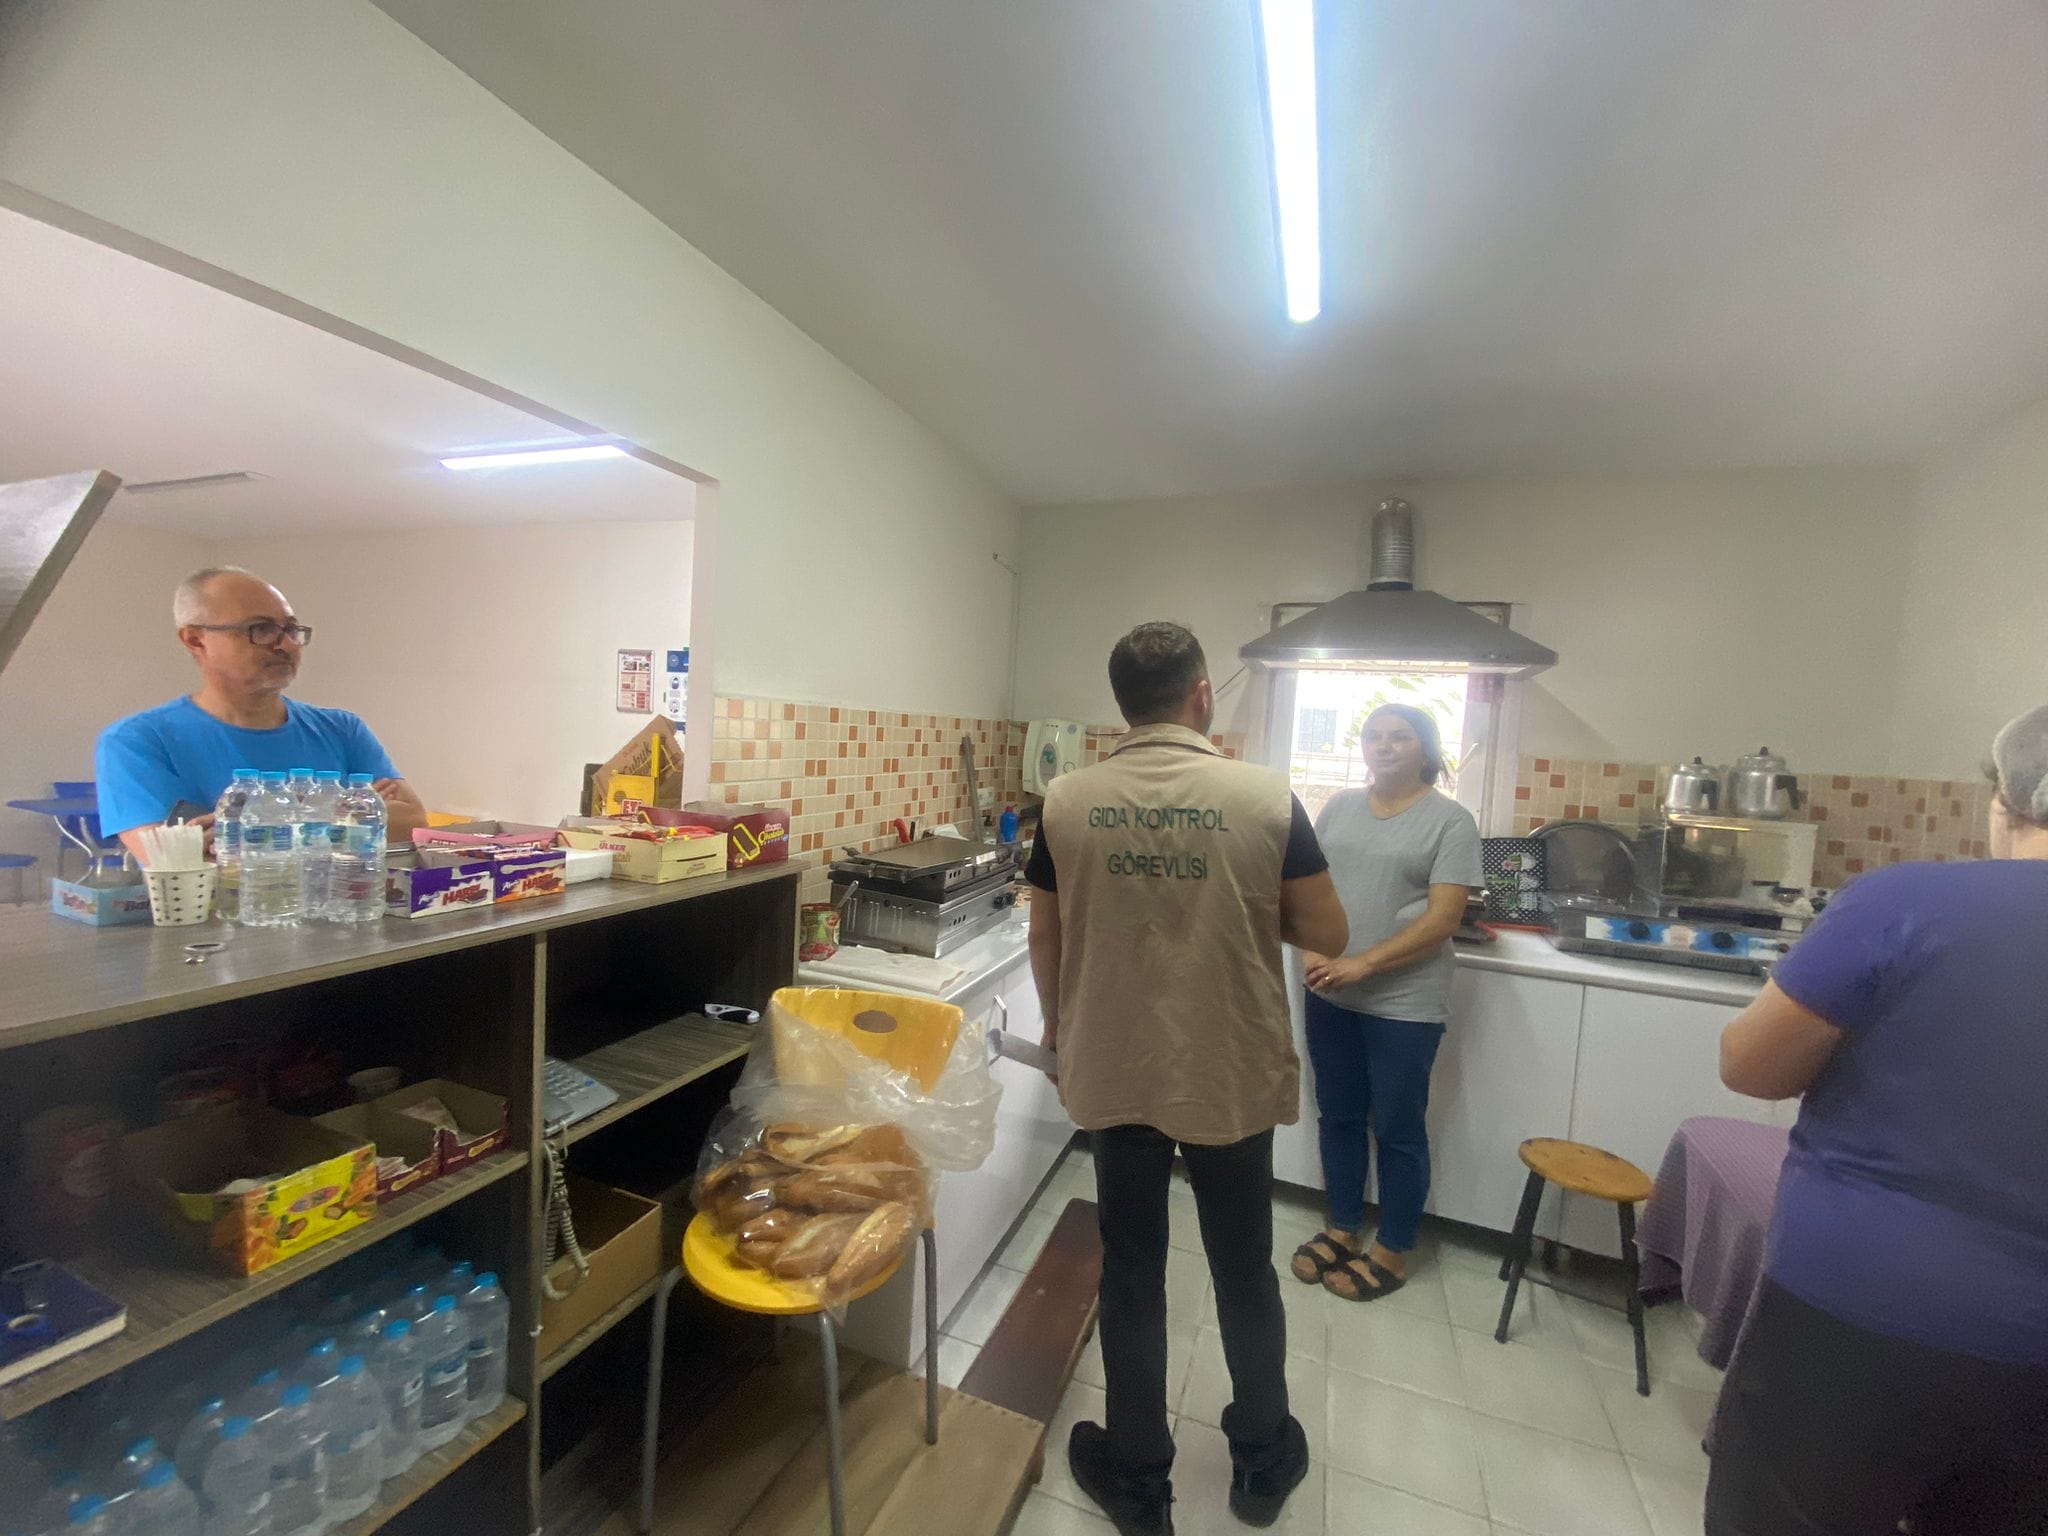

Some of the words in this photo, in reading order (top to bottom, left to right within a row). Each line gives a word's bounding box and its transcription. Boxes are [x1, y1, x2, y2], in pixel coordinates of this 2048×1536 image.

[623, 800, 643, 815] ET
[1088, 806, 1129, 829] GIDA
[1134, 807, 1229, 831] KONTROL
[599, 840, 626, 852] ÜLKER
